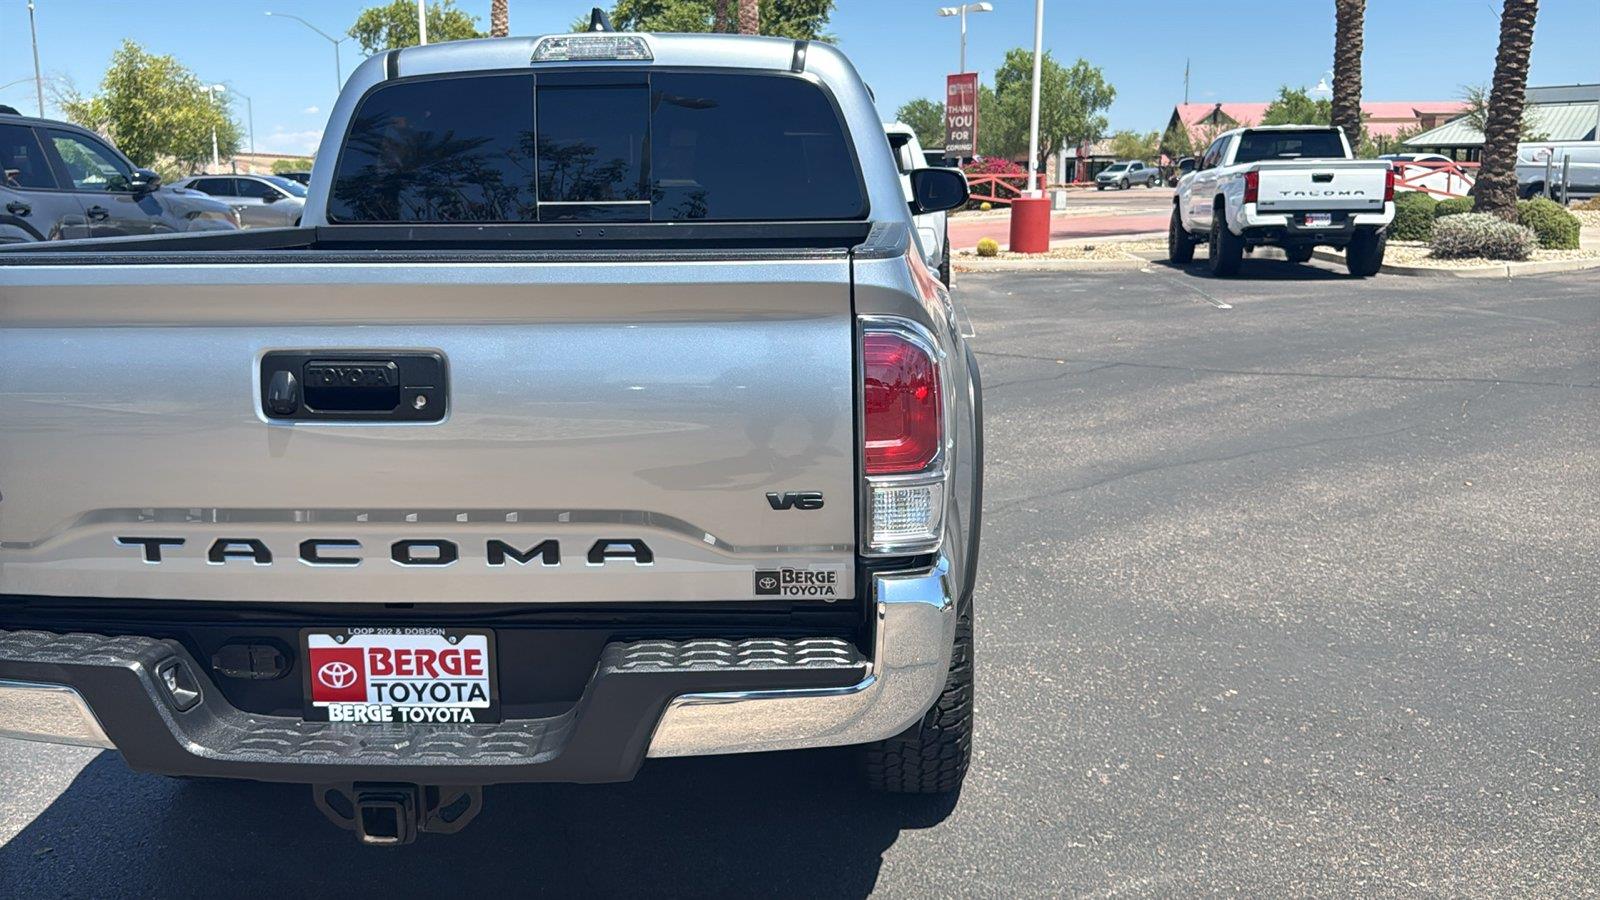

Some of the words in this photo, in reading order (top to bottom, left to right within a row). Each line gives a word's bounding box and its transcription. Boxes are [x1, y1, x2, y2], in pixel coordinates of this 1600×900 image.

[949, 106, 973, 114] THANK
[949, 116, 972, 127] YOU
[951, 130, 969, 140] FOR
[308, 367, 392, 385] TOYOTA
[766, 491, 824, 510] V6
[115, 536, 655, 567] TACOMA
[781, 569, 836, 585] BERGE
[781, 586, 835, 596] TOYOTA
[405, 628, 446, 636] DOBSON
[368, 647, 483, 679] BERGE
[371, 682, 488, 703] TOYOTA
[328, 702, 394, 724] BERGE
[398, 706, 475, 723] TOYOTA
